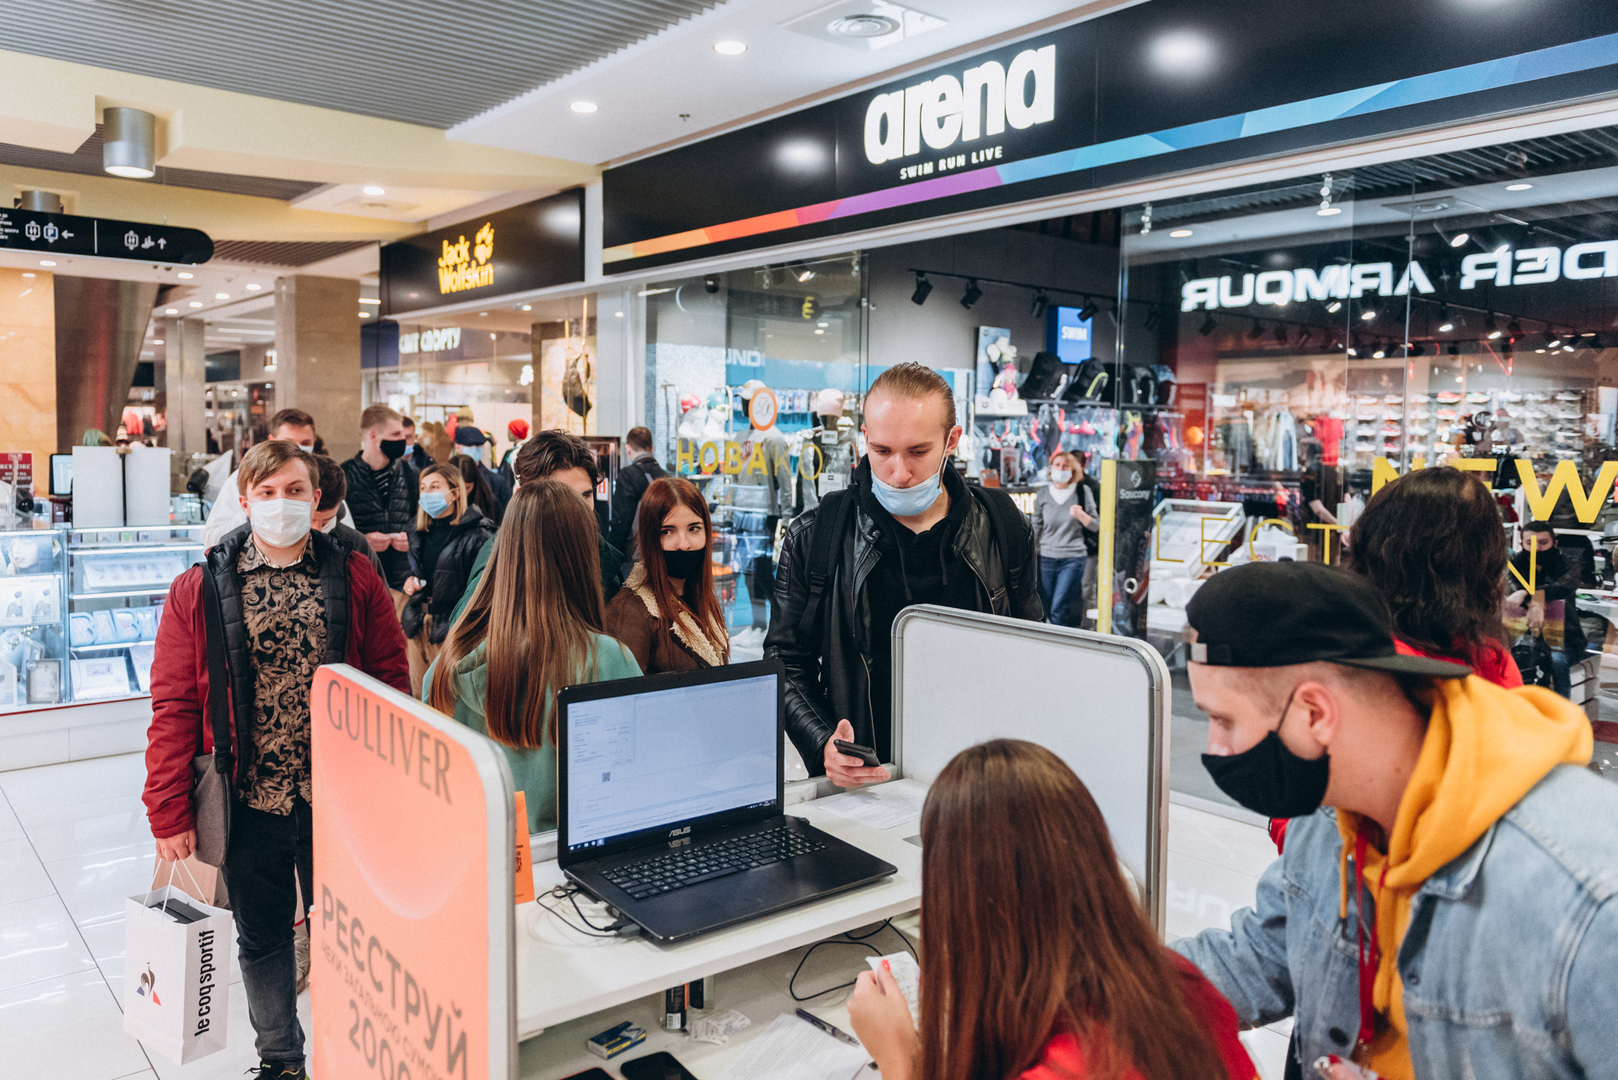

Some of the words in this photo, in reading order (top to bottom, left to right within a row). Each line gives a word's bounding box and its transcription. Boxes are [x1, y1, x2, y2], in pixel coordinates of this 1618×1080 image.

[863, 44, 1056, 165] arena
[900, 161, 934, 180] SWIM
[938, 154, 966, 172] RUN
[971, 145, 1003, 164] LIVE
[438, 235, 470, 268] Jack
[438, 260, 495, 294] Wolfskin
[678, 440, 769, 476] НОВА
[1119, 488, 1151, 501] Saucony
[70, 605, 157, 647] BABY
[327, 679, 452, 805] GULLIVER
[668, 826, 692, 838] ASUS
[322, 882, 467, 1080] РЕЄСТРУЙ
[344, 966, 400, 1044] ЗАГАЛЬНОЮ
[403, 1037, 441, 1080] СУМО
